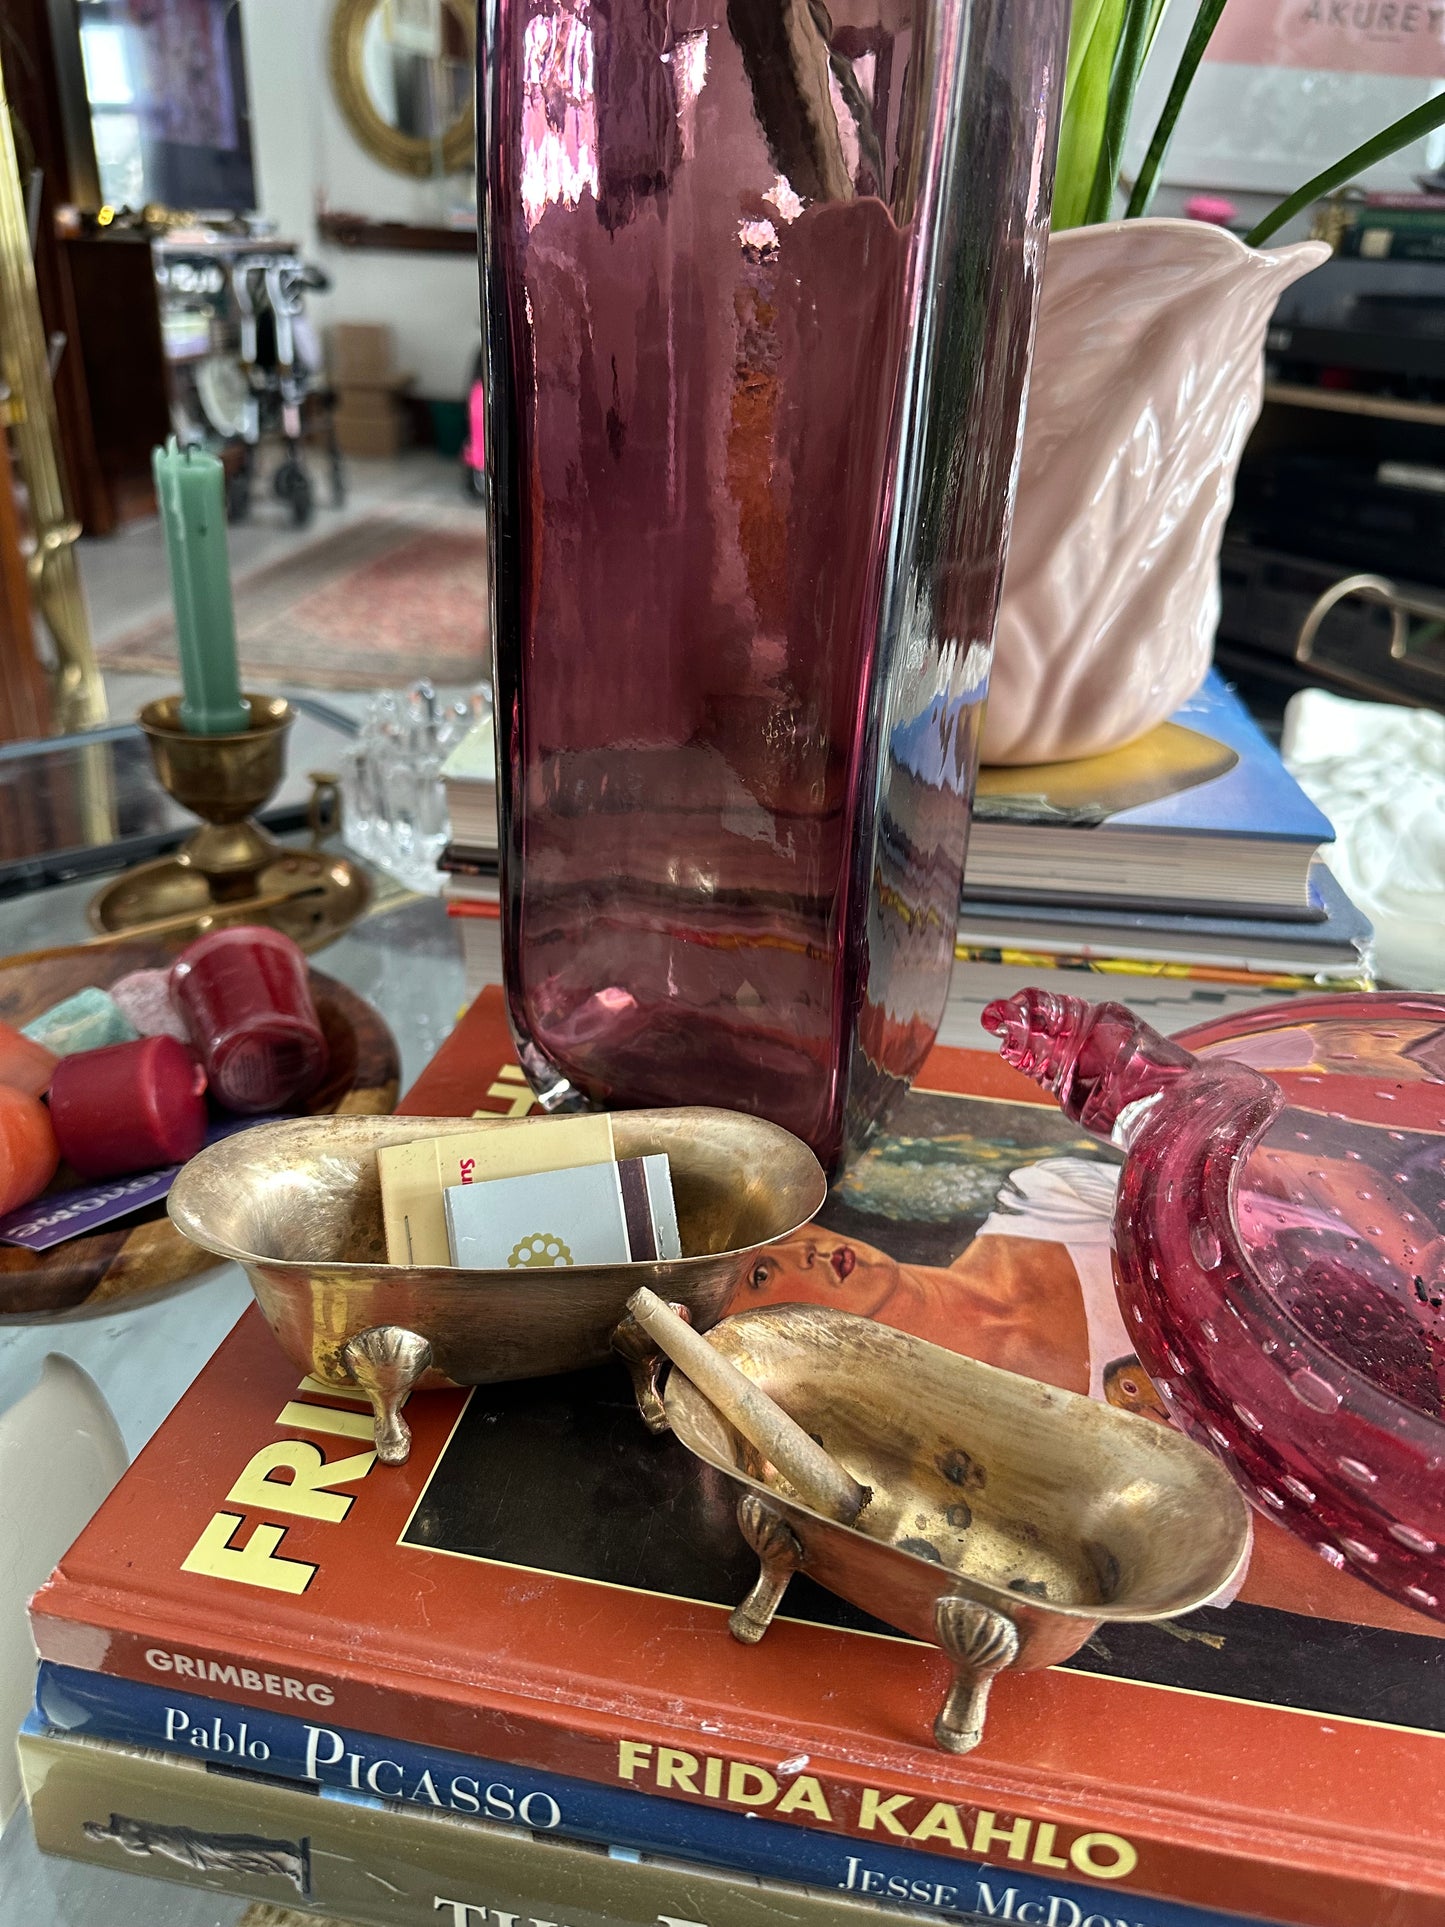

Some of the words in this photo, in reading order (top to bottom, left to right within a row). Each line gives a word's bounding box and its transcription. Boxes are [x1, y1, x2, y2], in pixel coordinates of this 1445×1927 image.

[145, 1648, 335, 1706] GRIMBERG
[164, 1707, 271, 1761] Pablo
[618, 1739, 834, 1821] FRIDA
[858, 1788, 1138, 1879] KAHLO
[838, 1855, 958, 1909] JESSE
